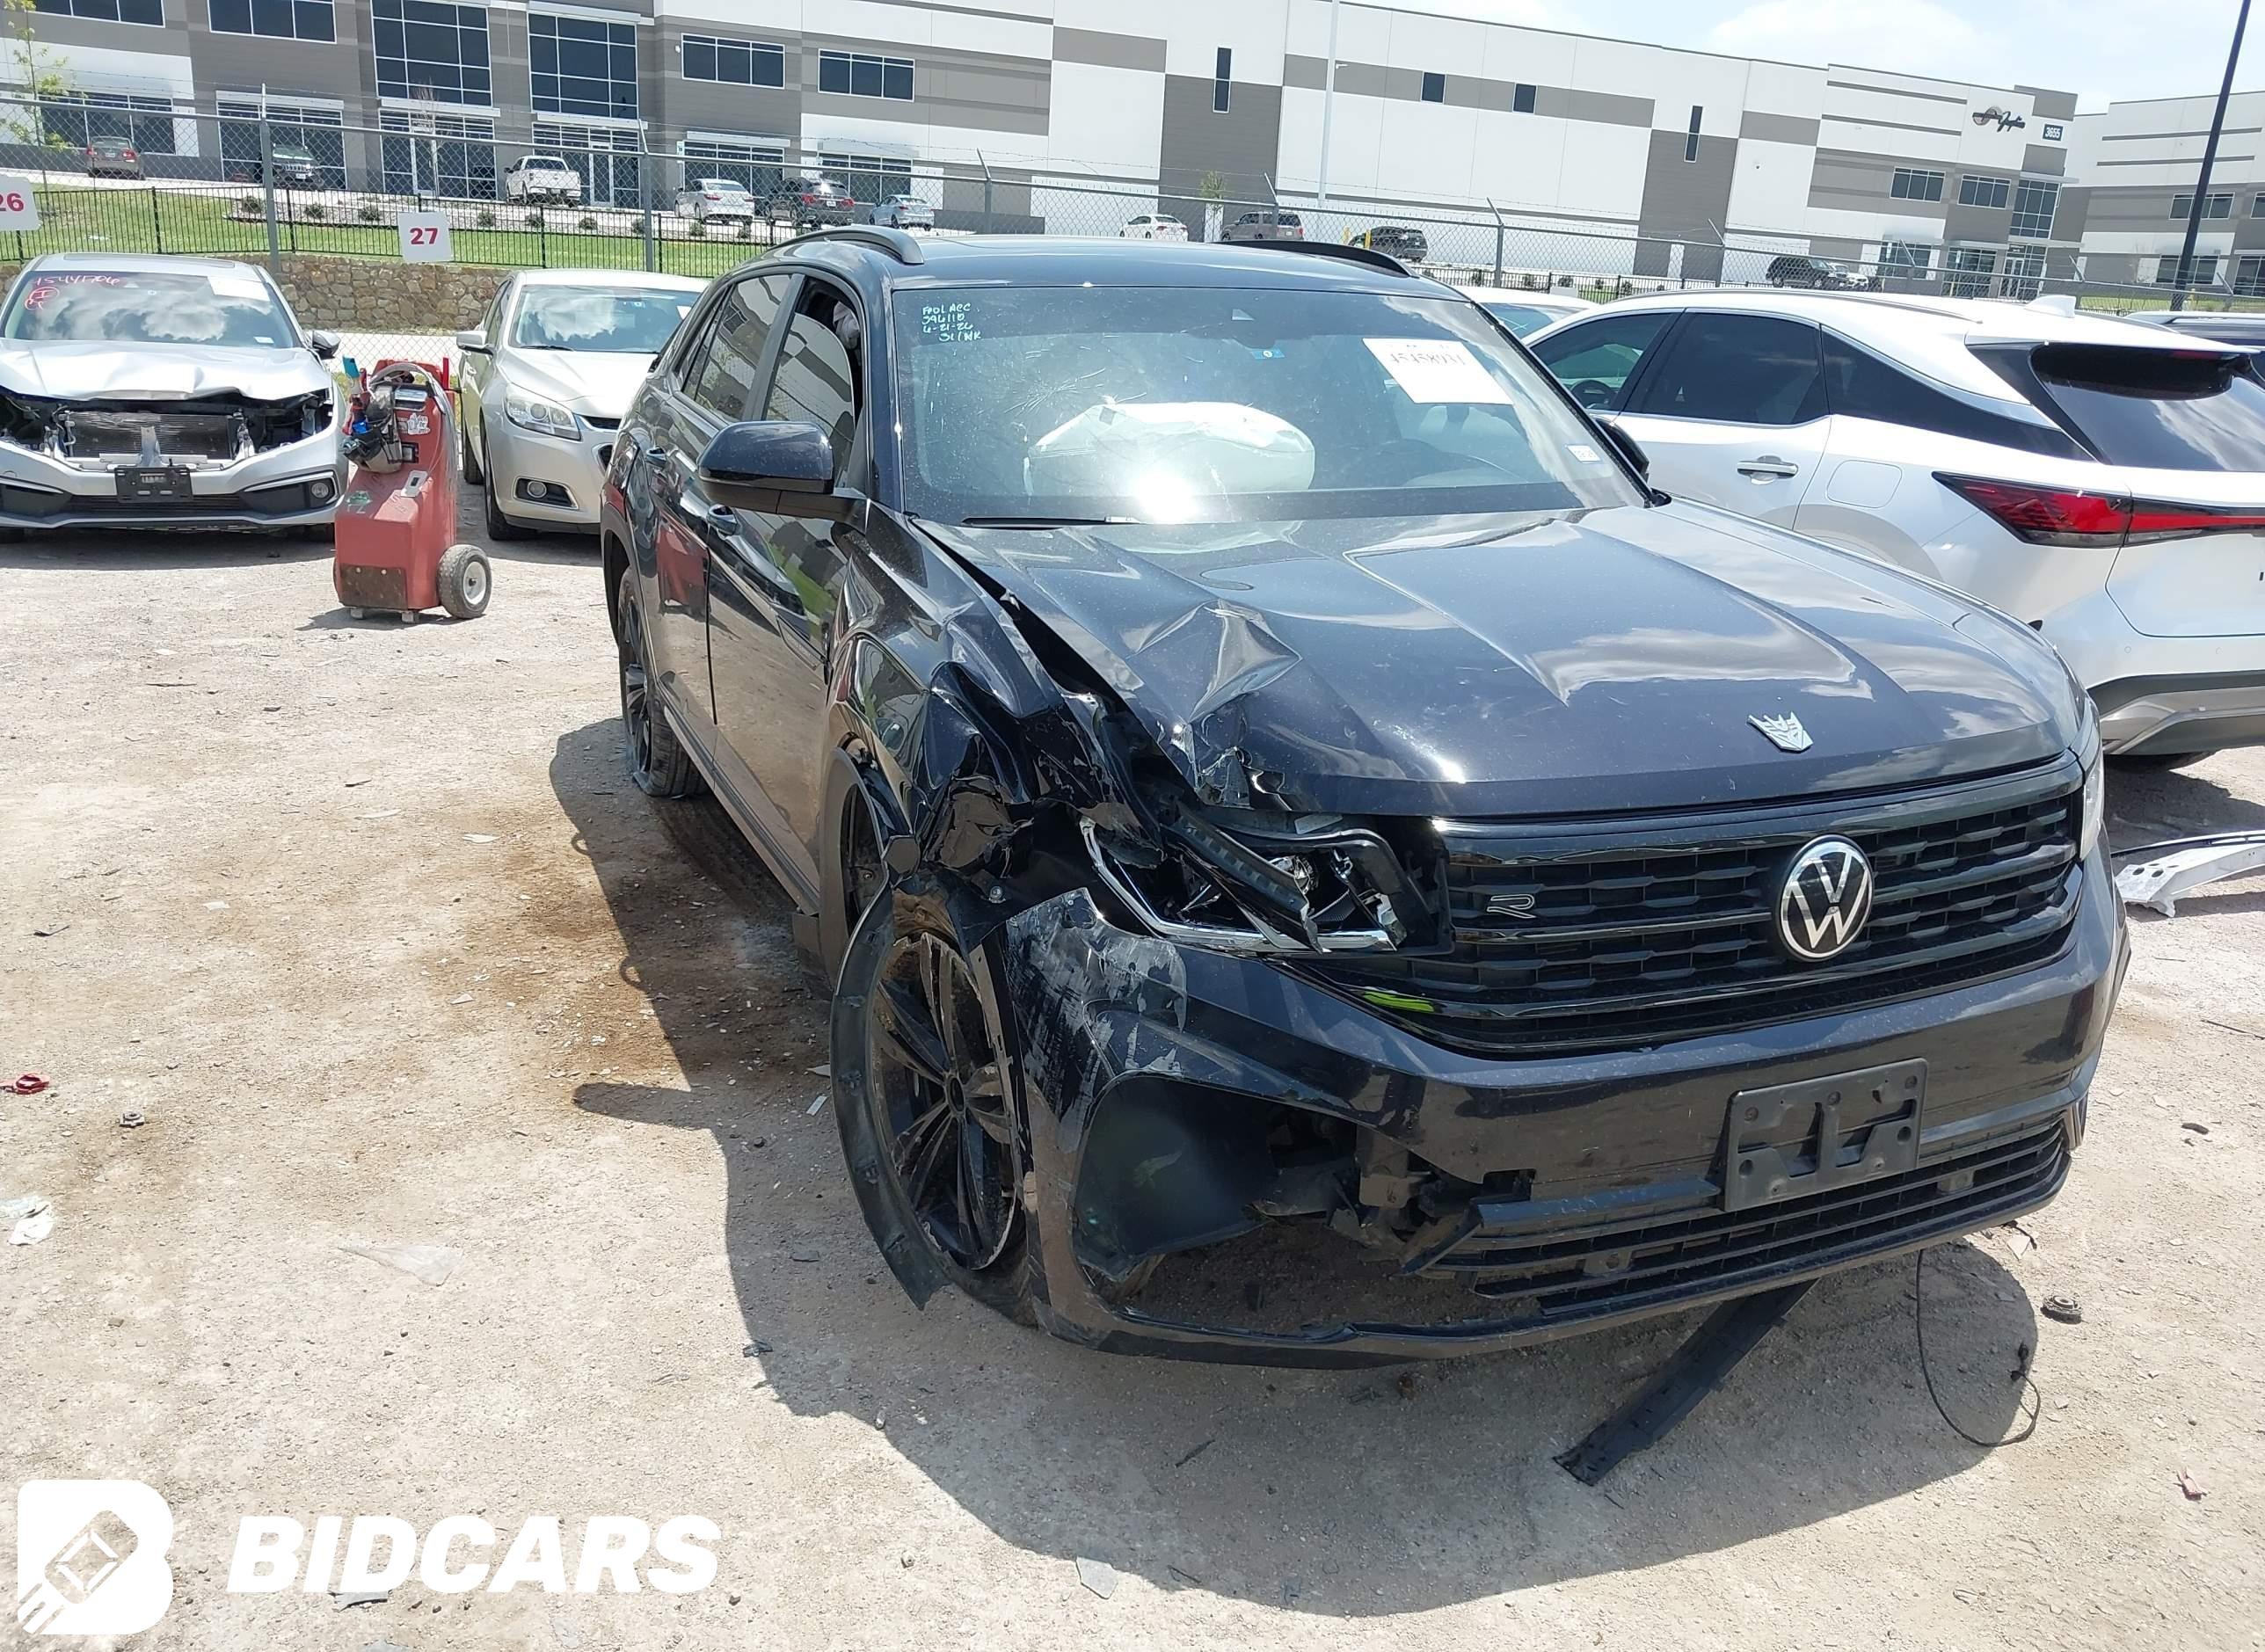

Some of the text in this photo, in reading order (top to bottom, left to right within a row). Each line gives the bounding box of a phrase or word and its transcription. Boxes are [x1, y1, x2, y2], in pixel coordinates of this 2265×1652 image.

[2044, 127, 2061, 139] 3655
[409, 227, 438, 245] 27
[1486, 893, 1537, 919] R
